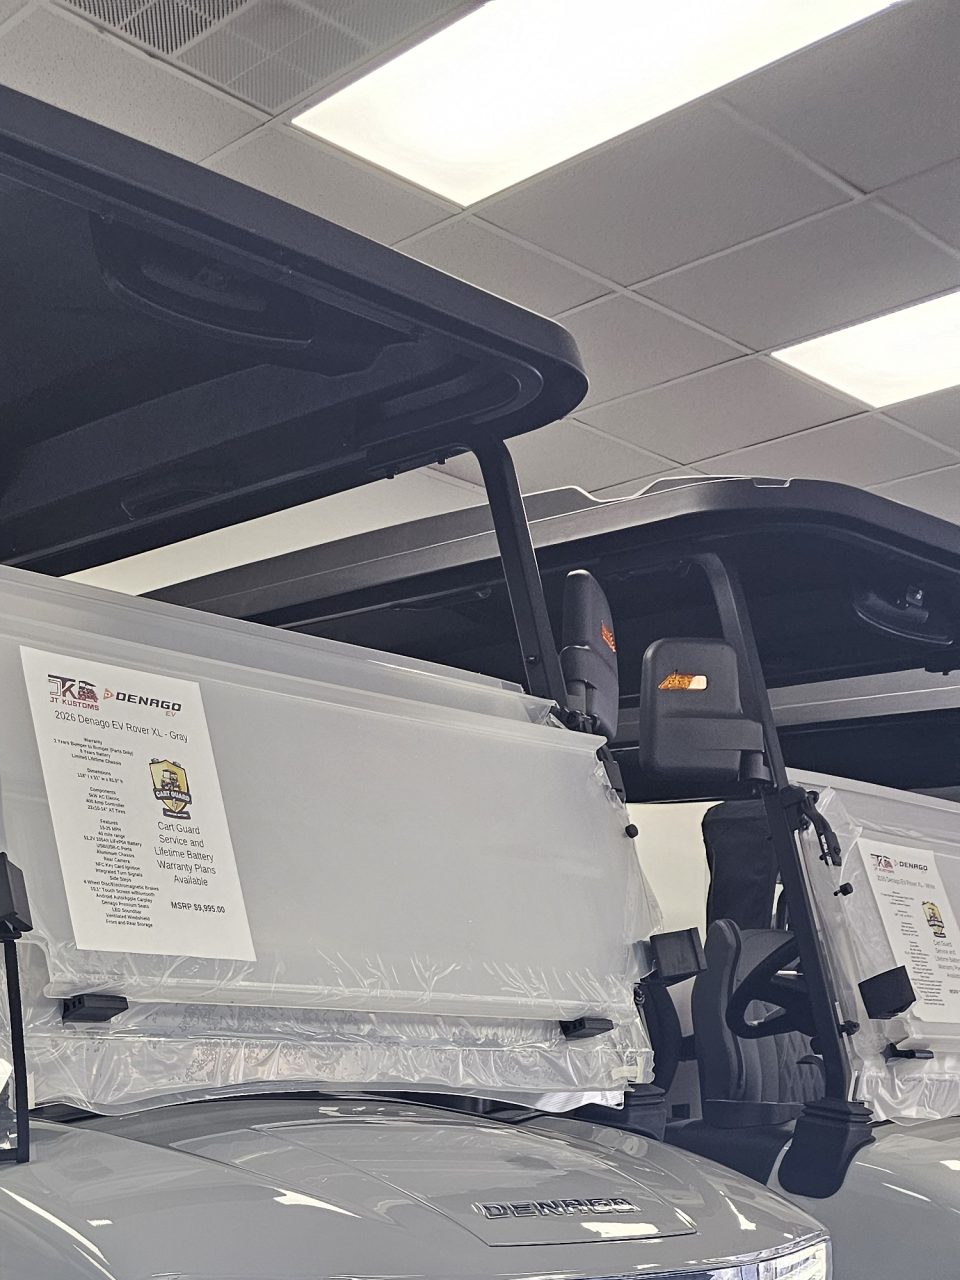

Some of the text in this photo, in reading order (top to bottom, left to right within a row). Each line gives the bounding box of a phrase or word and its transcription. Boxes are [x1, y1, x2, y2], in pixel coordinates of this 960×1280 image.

[62, 699, 100, 711] KUSTOMS
[115, 692, 182, 712] DENAGO
[54, 710, 76, 722] 2026
[78, 714, 110, 730] Denago
[112, 720, 124, 731] EV
[126, 722, 150, 736] Rover
[151, 728, 162, 738] XL
[169, 730, 189, 744] Gray
[158, 821, 200, 834] Cart Guard
[159, 834, 204, 848] Service and
[154, 846, 213, 863] Lifetime Battery
[157, 860, 216, 874] Warranty Plans
[899, 861, 928, 871] DENAGO
[174, 875, 208, 886] Available
[171, 901, 225, 913] MSRP $9,995.00
[481, 1198, 636, 1220] DENAGO
